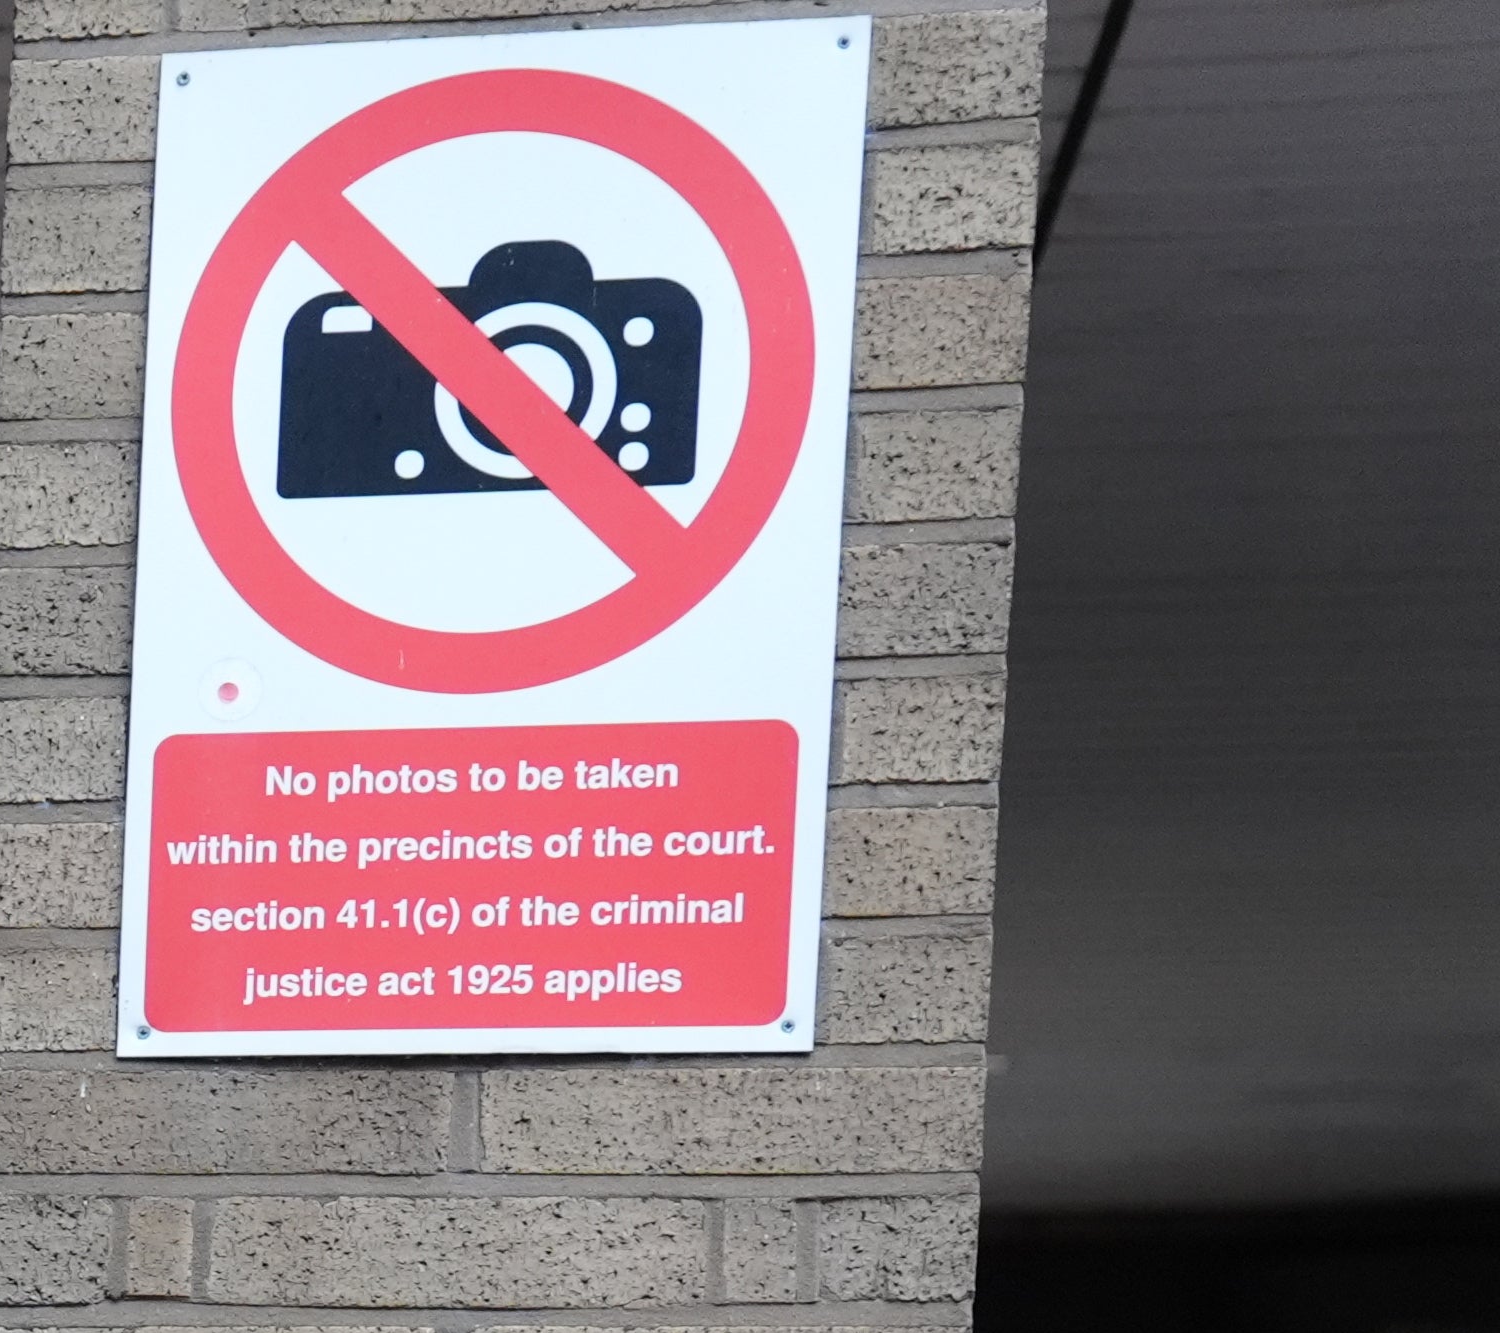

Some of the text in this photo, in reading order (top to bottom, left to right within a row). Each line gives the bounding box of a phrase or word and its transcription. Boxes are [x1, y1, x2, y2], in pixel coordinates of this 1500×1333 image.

[265, 757, 679, 803] No photos to be taken
[166, 825, 775, 870] within the precincts of the court.
[190, 892, 744, 935] section 41.1(c) of the criminal
[242, 962, 682, 1006] justice act 1925 applies
